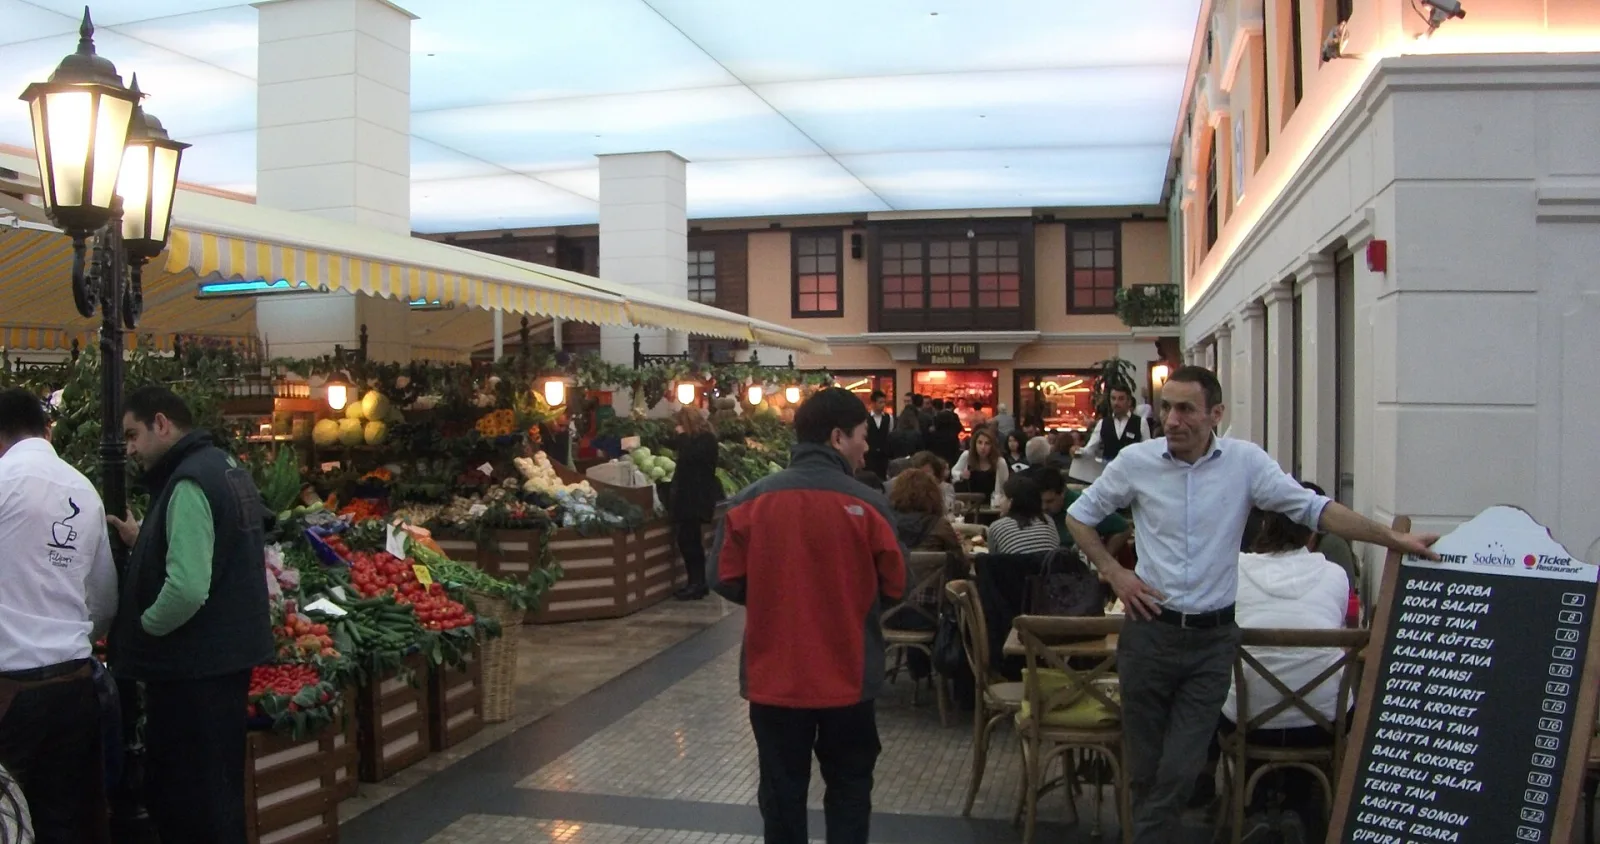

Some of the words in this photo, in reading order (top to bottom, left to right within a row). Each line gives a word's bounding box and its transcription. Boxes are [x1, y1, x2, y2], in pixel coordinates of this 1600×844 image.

[1418, 553, 1468, 564] TINET
[1472, 552, 1516, 566] Sodexho
[1538, 554, 1572, 566] Ticket
[1406, 579, 1444, 592] BALIK
[1447, 583, 1492, 597] ÇORBA
[1402, 596, 1437, 608] ROKA
[1440, 600, 1489, 614] SALATA
[1445, 617, 1477, 630] TAVA
[1396, 628, 1434, 642] BALIK
[1564, 630, 1576, 640] 10
[1393, 645, 1456, 662] KALAMAR
[1459, 653, 1492, 667] TAVA
[1382, 694, 1420, 709] BALIK
[1423, 701, 1478, 718] KROKET
[1379, 711, 1444, 731] SARDALYA
[1446, 722, 1480, 737] TAVA
[1371, 744, 1411, 760] BALIK
[1413, 752, 1474, 774] KOKOREÇ
[1431, 773, 1483, 793] SALATA
[1404, 786, 1437, 802] TAVA
[1356, 812, 1407, 831] LEVREK
[1417, 807, 1469, 826] SOMON
